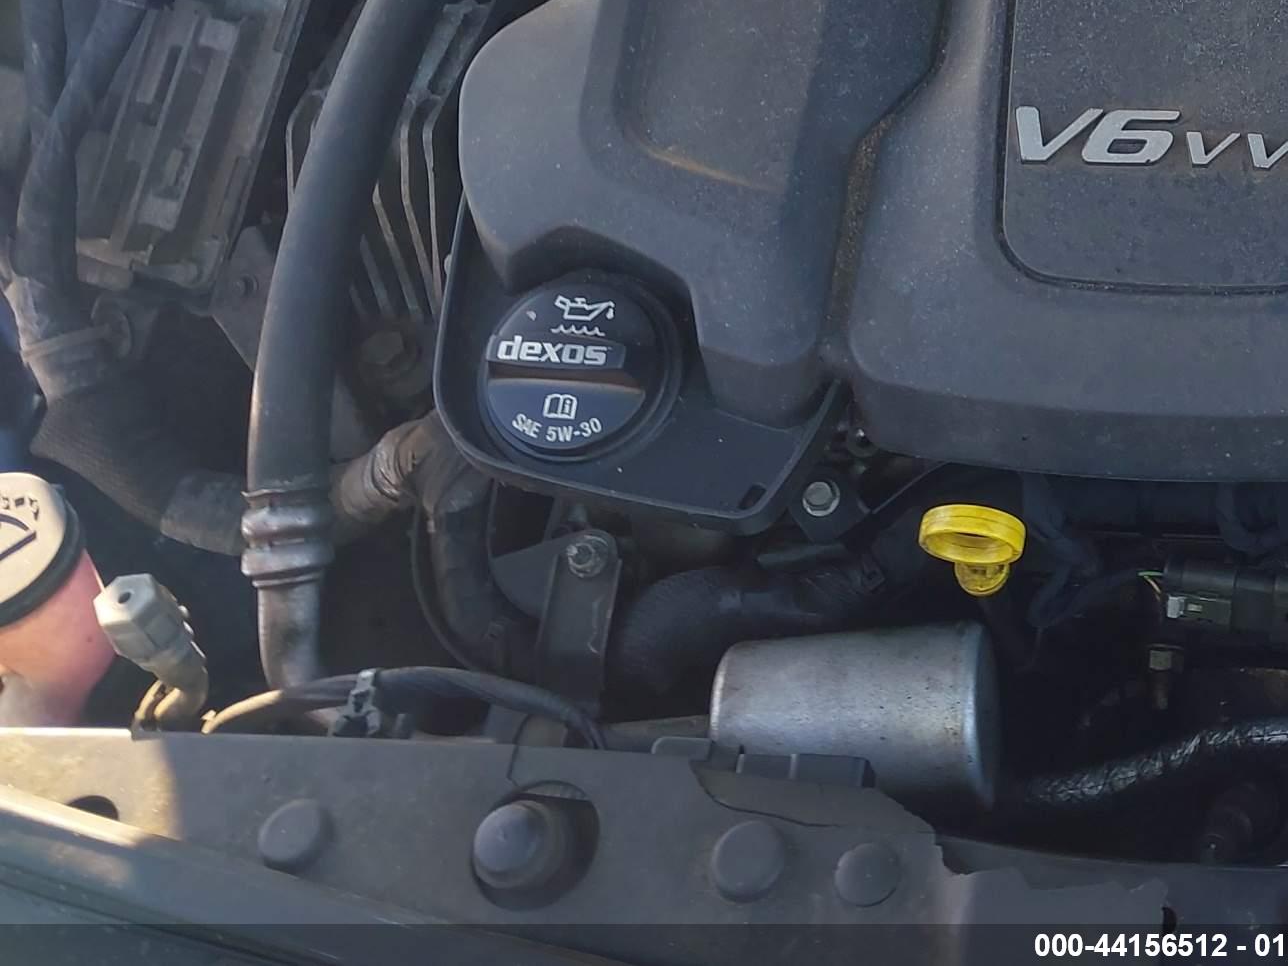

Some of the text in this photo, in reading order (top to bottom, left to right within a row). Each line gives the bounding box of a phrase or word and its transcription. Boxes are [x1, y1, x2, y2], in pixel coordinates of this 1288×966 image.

[1015, 105, 1181, 165] V6
[497, 335, 609, 365] dexos
[512, 413, 602, 442] SAE 5W-30
